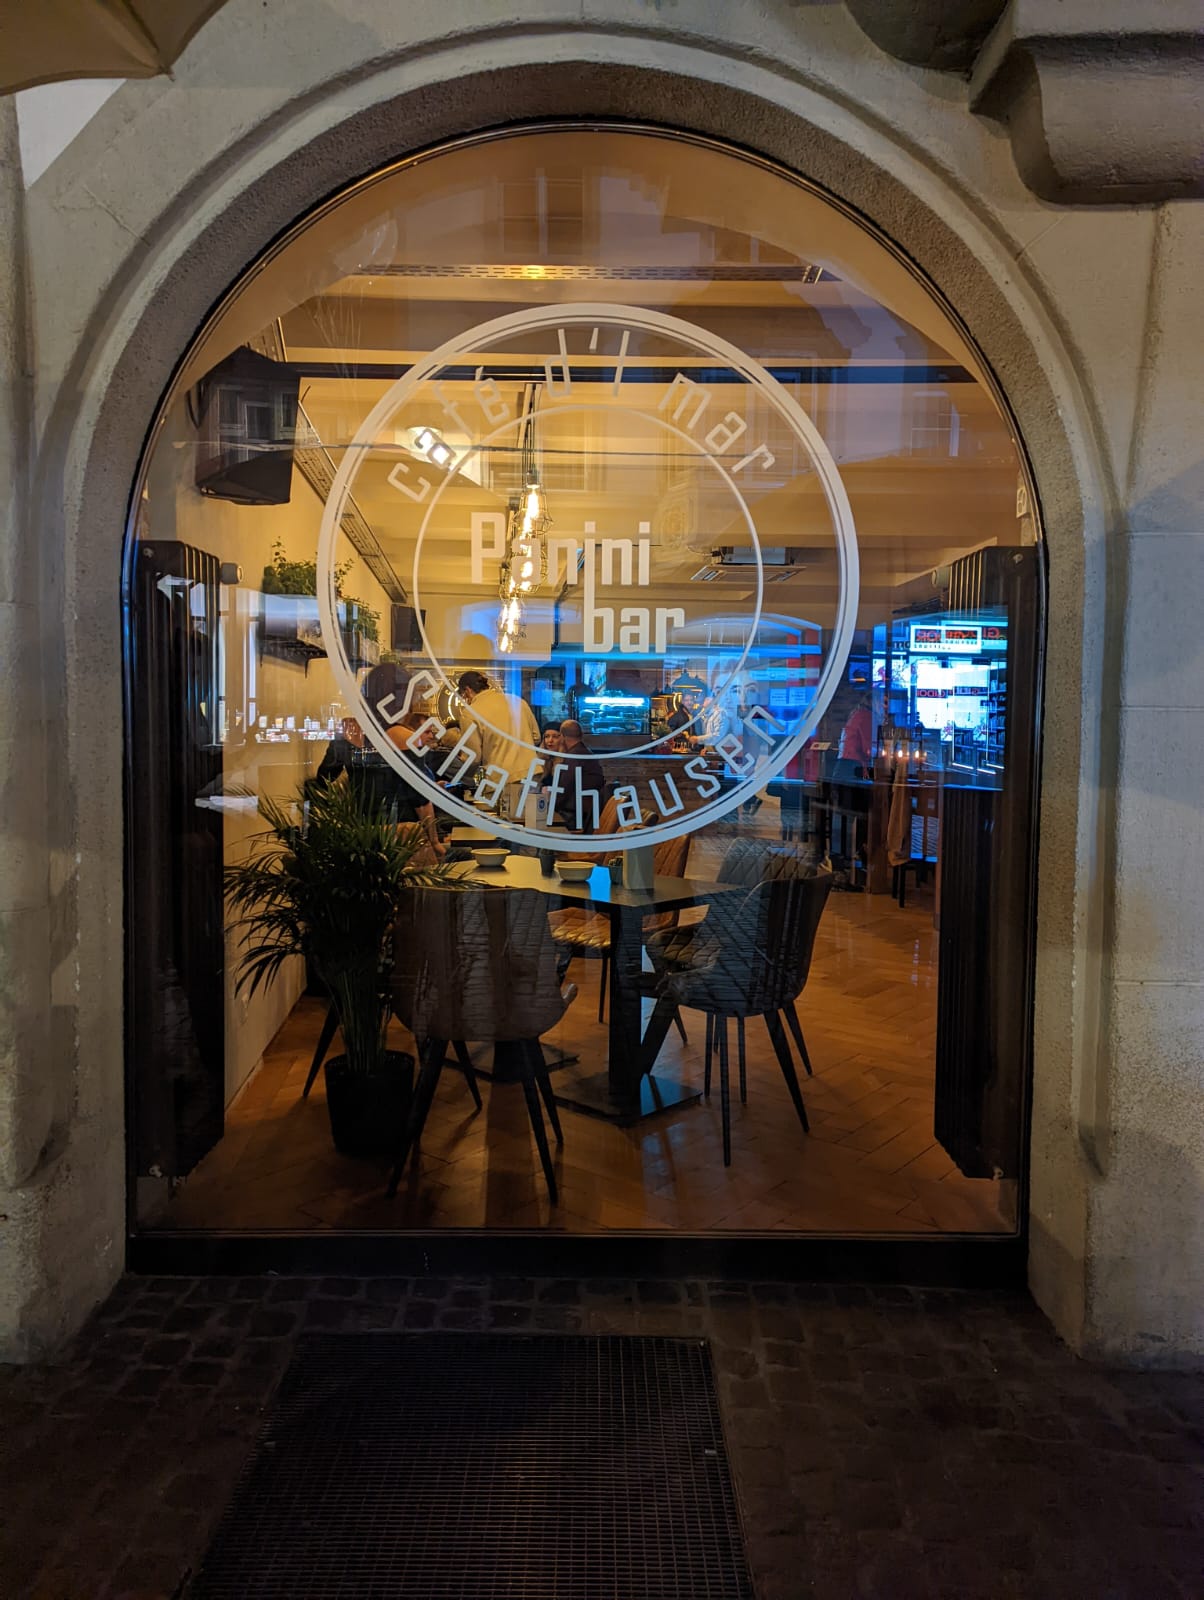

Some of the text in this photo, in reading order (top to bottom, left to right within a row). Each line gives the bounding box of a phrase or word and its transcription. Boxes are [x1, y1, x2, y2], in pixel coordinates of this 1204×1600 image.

[658, 372, 776, 473] mar
[471, 512, 650, 585] Panini
[583, 583, 685, 653] bar
[375, 669, 787, 829] Schaffhausen
